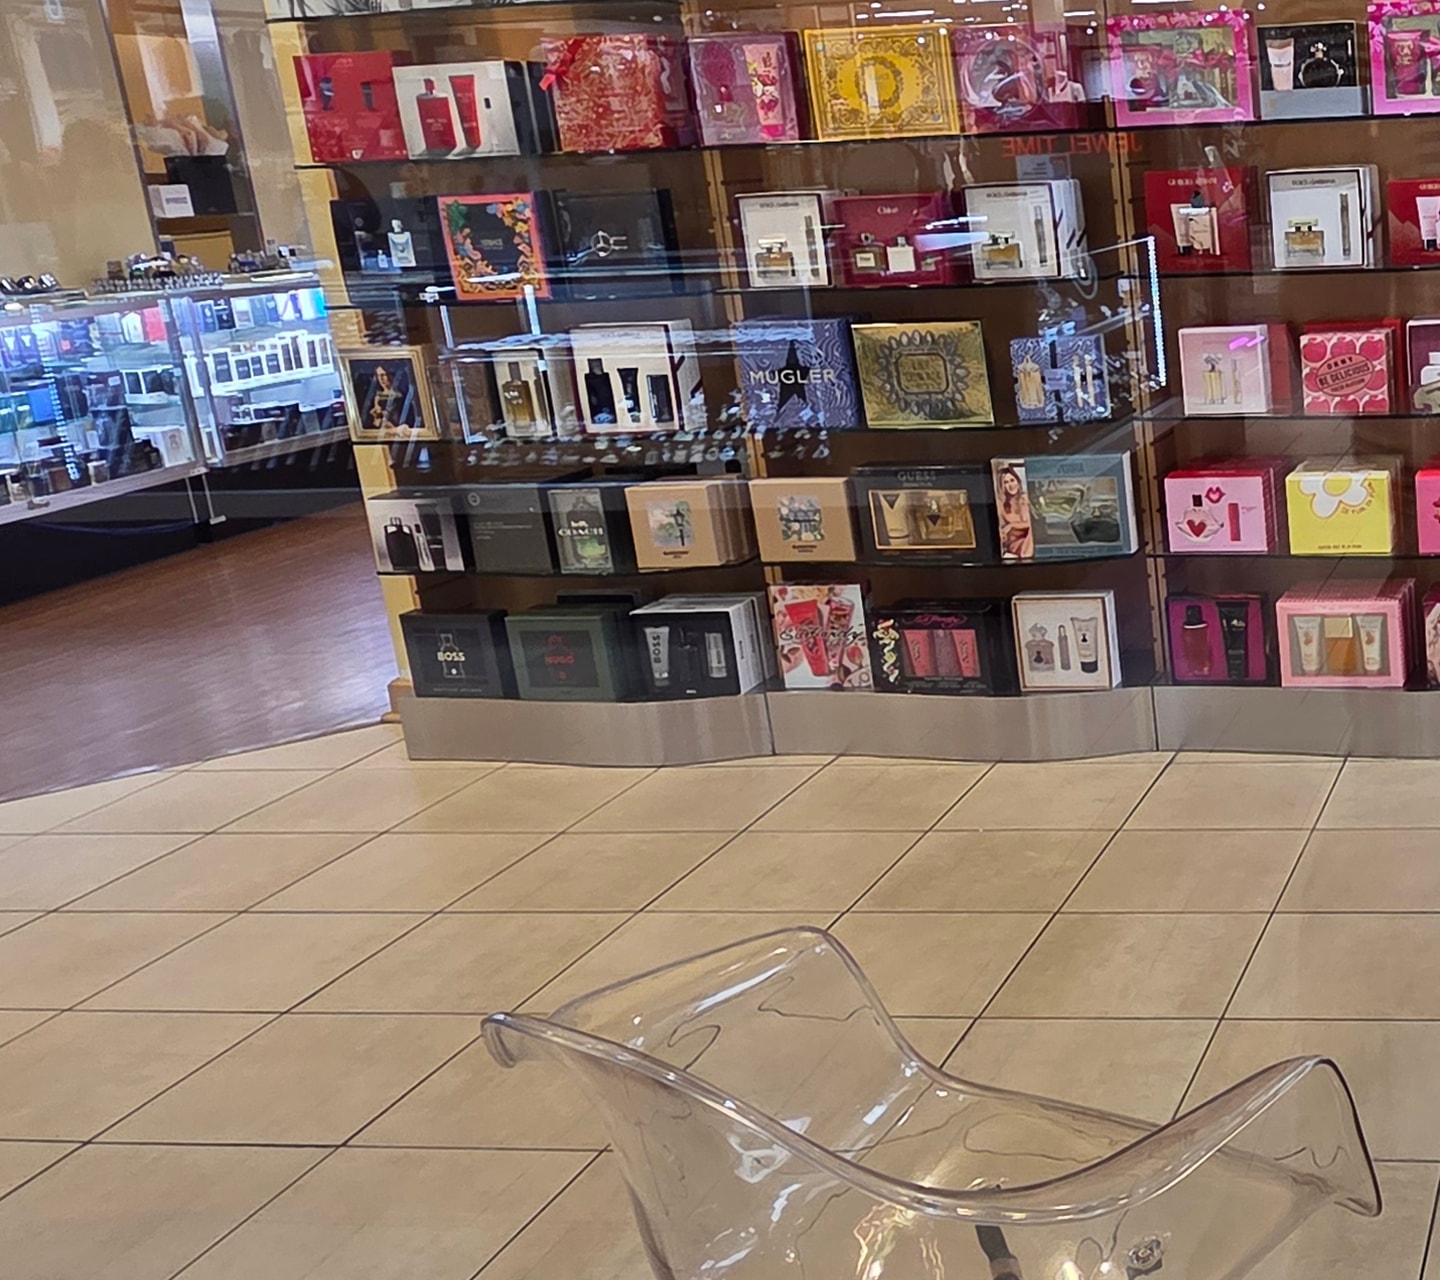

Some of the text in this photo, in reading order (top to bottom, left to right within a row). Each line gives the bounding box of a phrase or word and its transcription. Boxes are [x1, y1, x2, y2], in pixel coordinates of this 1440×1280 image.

[749, 369, 835, 385] MUGLER
[1330, 362, 1371, 383] DELICIOUS
[897, 471, 937, 481] GUESS
[558, 527, 604, 537] COACH
[652, 634, 663, 664] BOSS
[437, 651, 466, 662] BOSS
